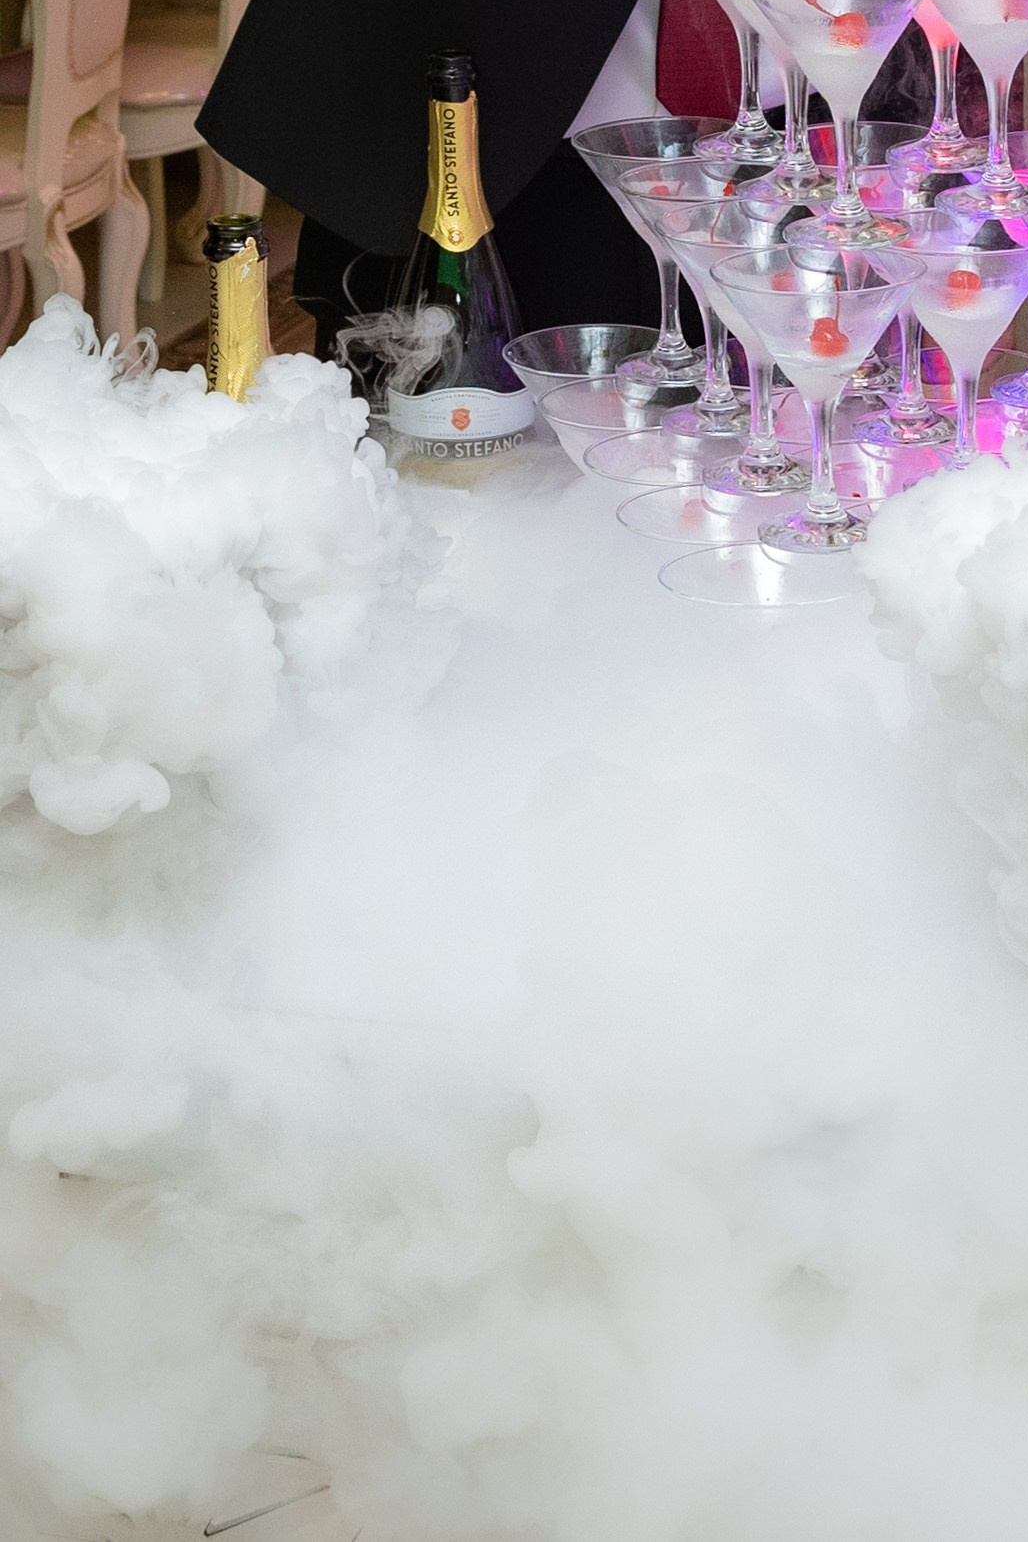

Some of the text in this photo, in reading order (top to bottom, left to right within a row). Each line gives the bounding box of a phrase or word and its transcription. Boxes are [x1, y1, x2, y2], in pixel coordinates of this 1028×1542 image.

[443, 108, 460, 217] SANTO STEFANO
[208, 265, 220, 340] STEFANO
[454, 433, 524, 458] STEFANO
